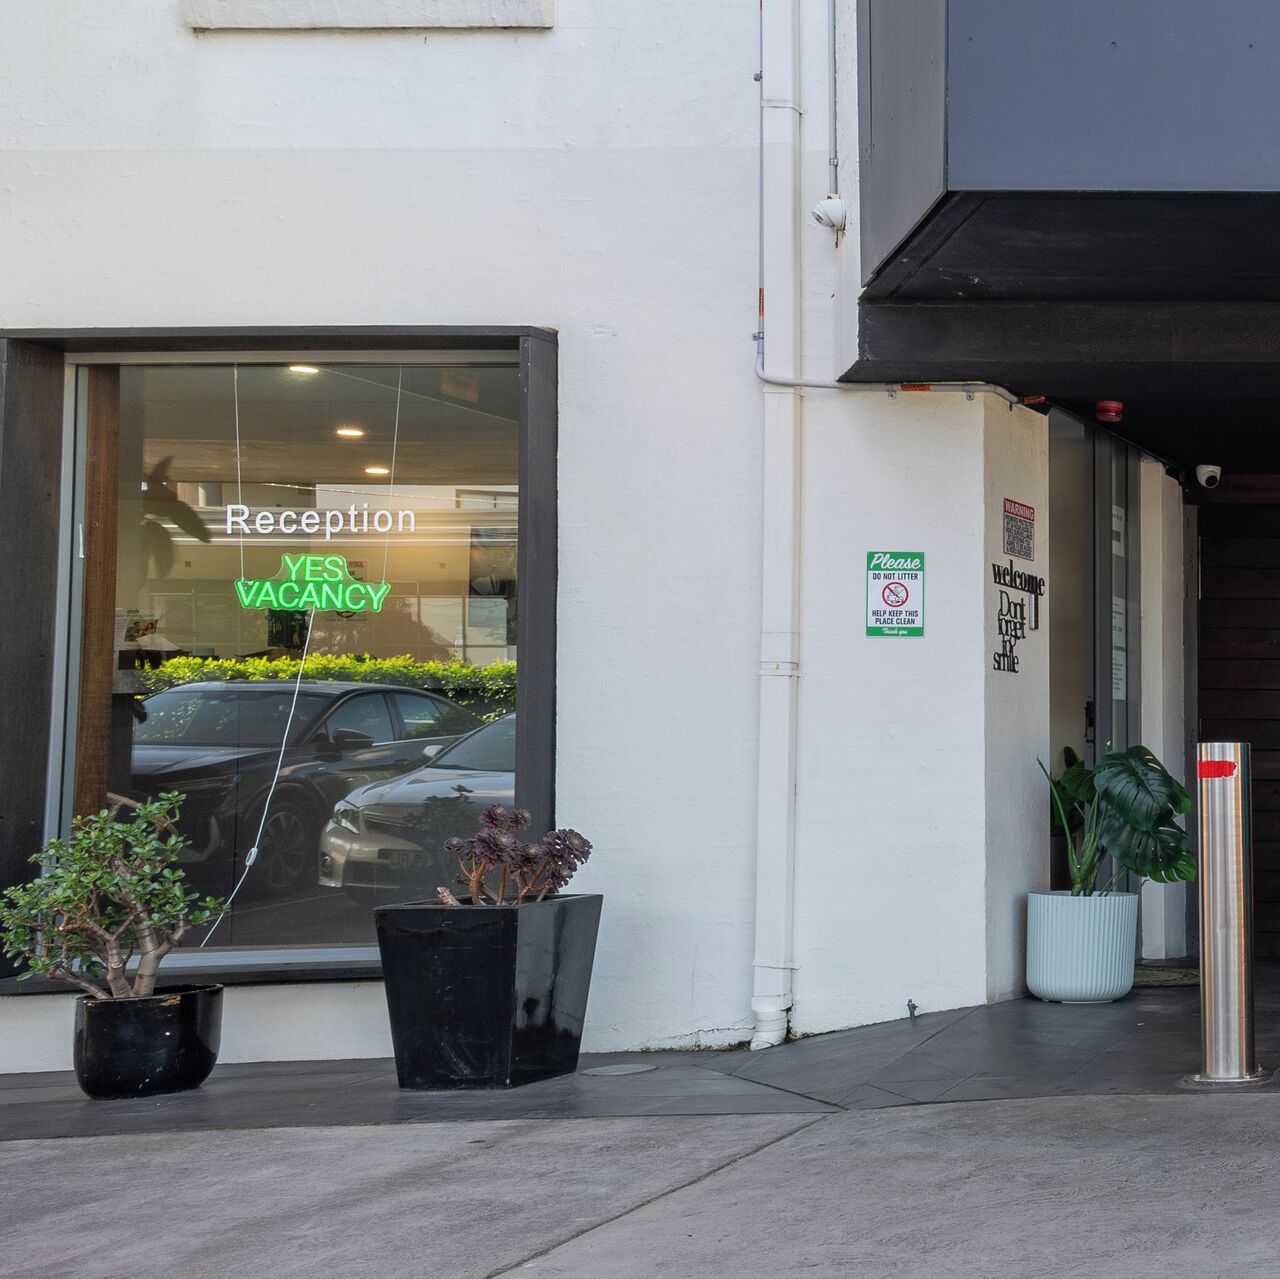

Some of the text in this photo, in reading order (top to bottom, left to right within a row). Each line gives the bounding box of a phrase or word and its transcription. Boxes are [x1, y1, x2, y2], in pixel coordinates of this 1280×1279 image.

[226, 503, 416, 541] Reception
[1005, 500, 1034, 520] WARNING
[284, 555, 344, 583] YES
[870, 553, 921, 569] Please
[992, 559, 1045, 596] welcome
[237, 582, 388, 610] VACANCY
[993, 651, 1019, 673] smile
